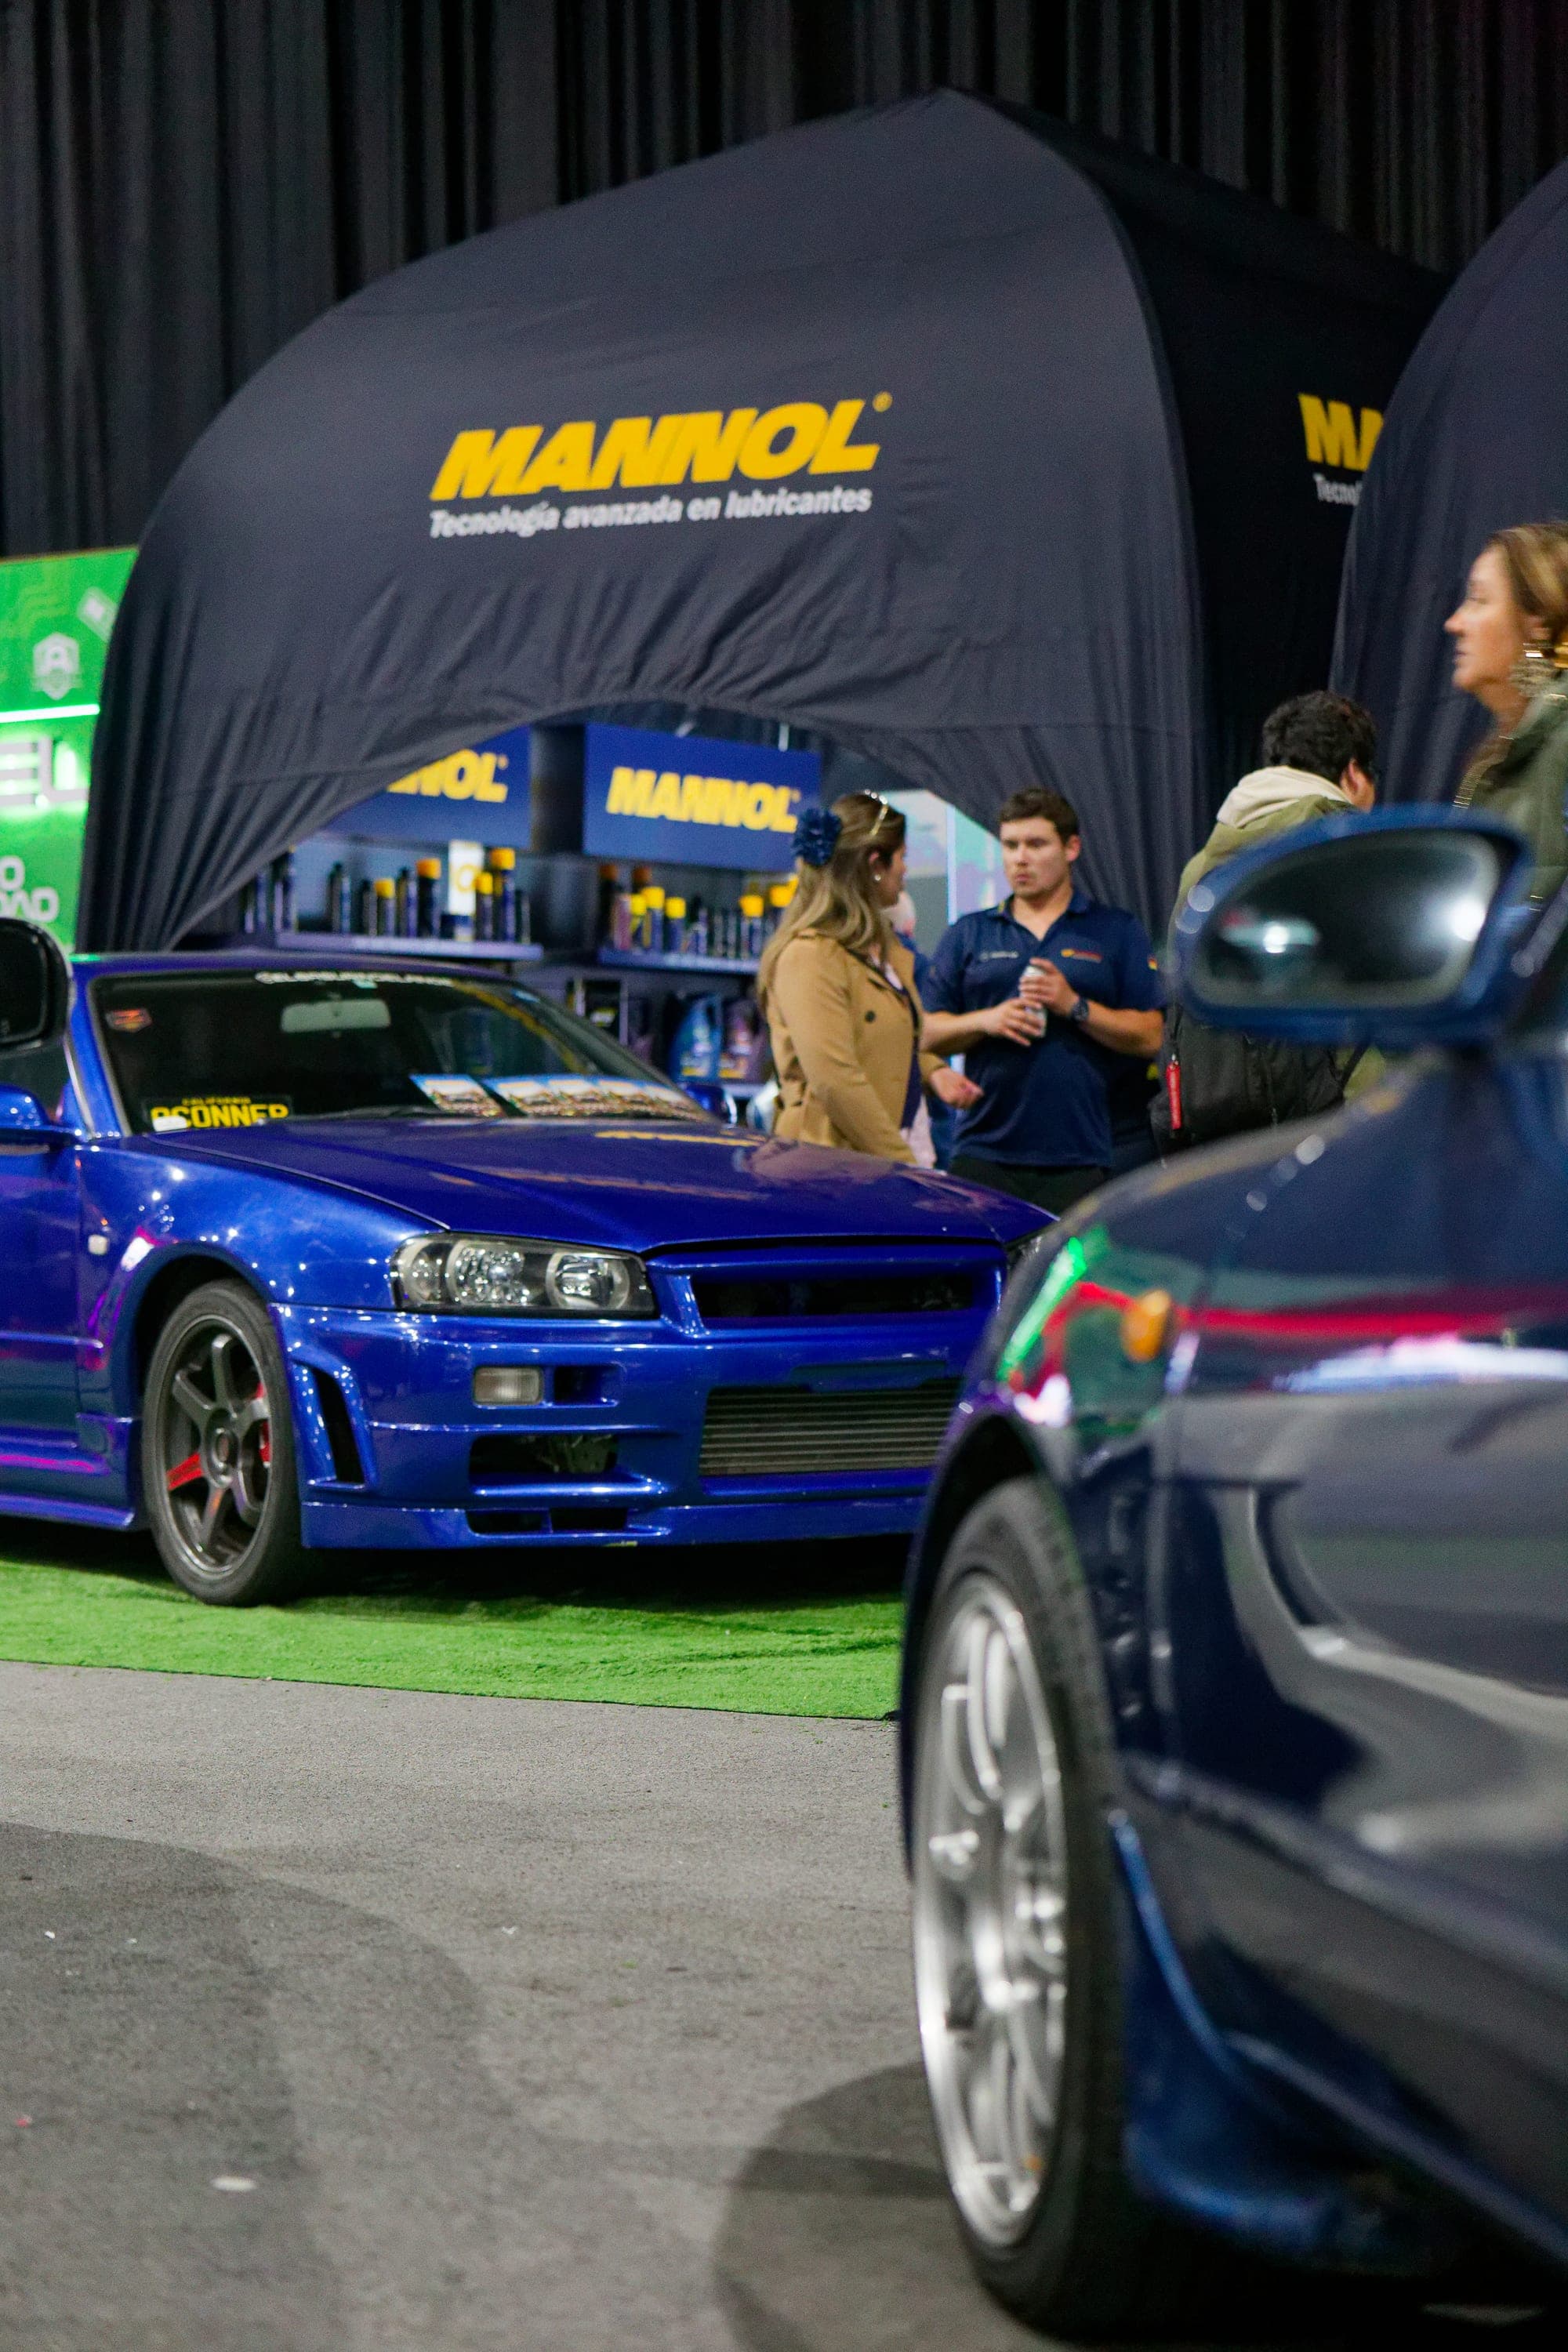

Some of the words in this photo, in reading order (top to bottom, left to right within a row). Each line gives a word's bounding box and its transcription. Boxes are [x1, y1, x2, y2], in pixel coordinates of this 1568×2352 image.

[429, 398, 881, 501] MANNOL
[430, 501, 558, 539] Tecnología
[562, 495, 681, 530] avanzada
[687, 502, 720, 521] en
[724, 487, 873, 519] lubricantes
[387, 748, 509, 804] NOL
[606, 767, 799, 833] MANNOL
